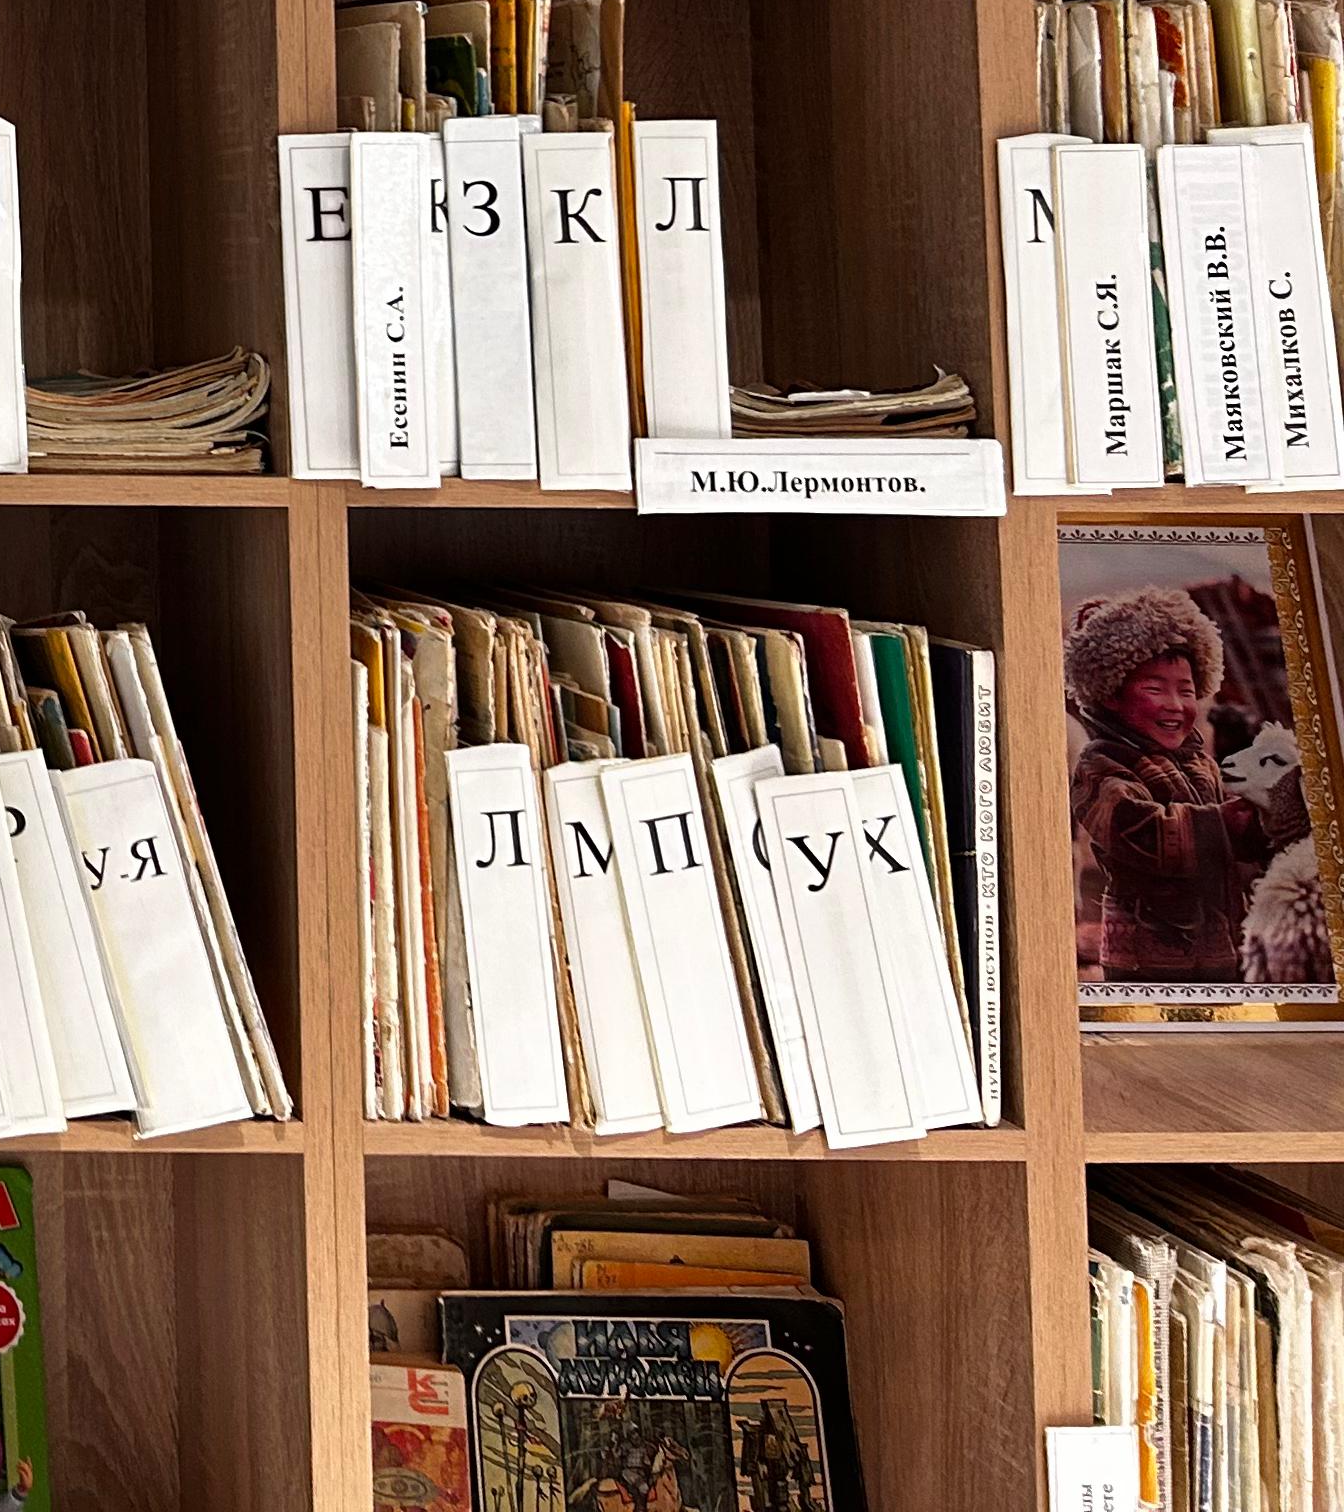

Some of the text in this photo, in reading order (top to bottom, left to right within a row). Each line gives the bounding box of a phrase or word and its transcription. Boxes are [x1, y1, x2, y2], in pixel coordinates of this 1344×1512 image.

[305, 187, 352, 243] Е
[462, 180, 502, 238] З
[550, 187, 607, 245] К
[655, 176, 709, 234] Л
[386, 285, 408, 451] Есенин С.А.
[1095, 273, 1130, 458] Маршак С.Я.
[1205, 224, 1248, 463] Маяковский В.В.
[1268, 270, 1310, 450] Михалков С.
[690, 469, 927, 498] М.Ю.Лермонтов.
[977, 683, 996, 899] КТО КОГО ЛЮБИТ
[475, 809, 531, 869] Л
[640, 811, 703, 876] П
[785, 830, 845, 893] У
[863, 814, 911, 875] Х
